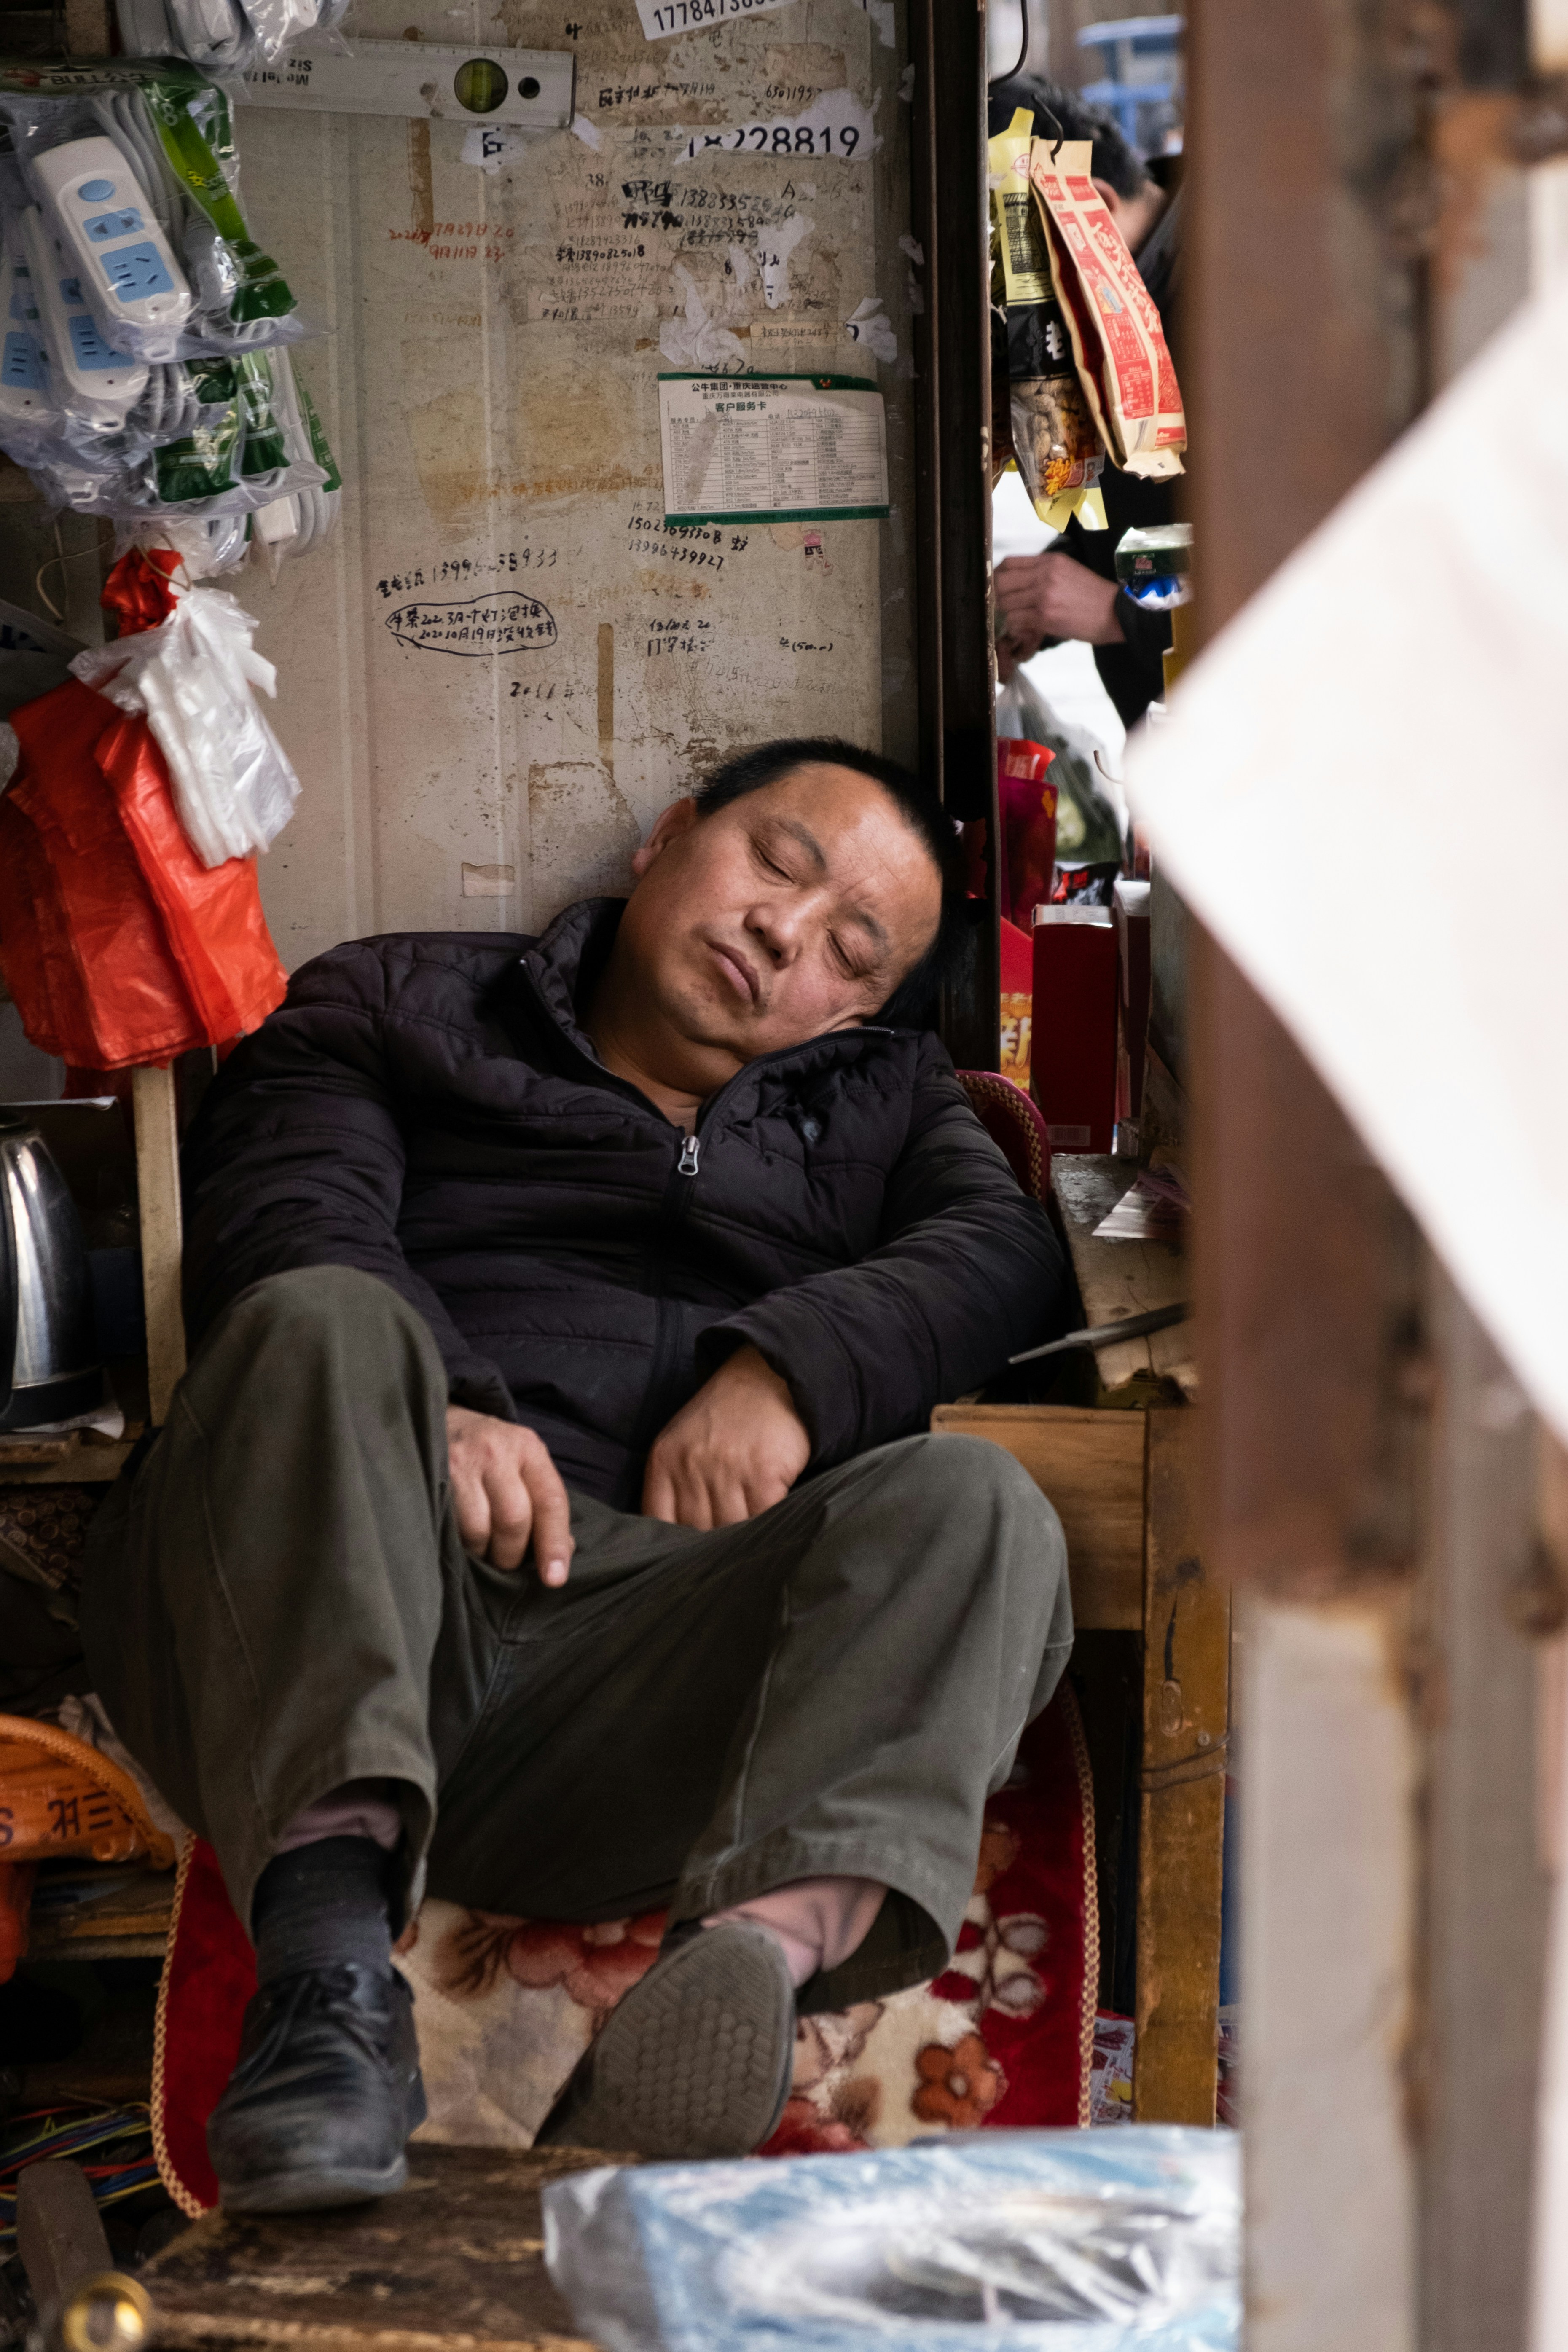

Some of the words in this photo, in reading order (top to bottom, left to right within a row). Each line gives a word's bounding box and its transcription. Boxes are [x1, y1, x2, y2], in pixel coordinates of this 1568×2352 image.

[692, 382, 787, 392] 公牛集团·重庆运营中心
[715, 401, 767, 412] 客户服务卡
